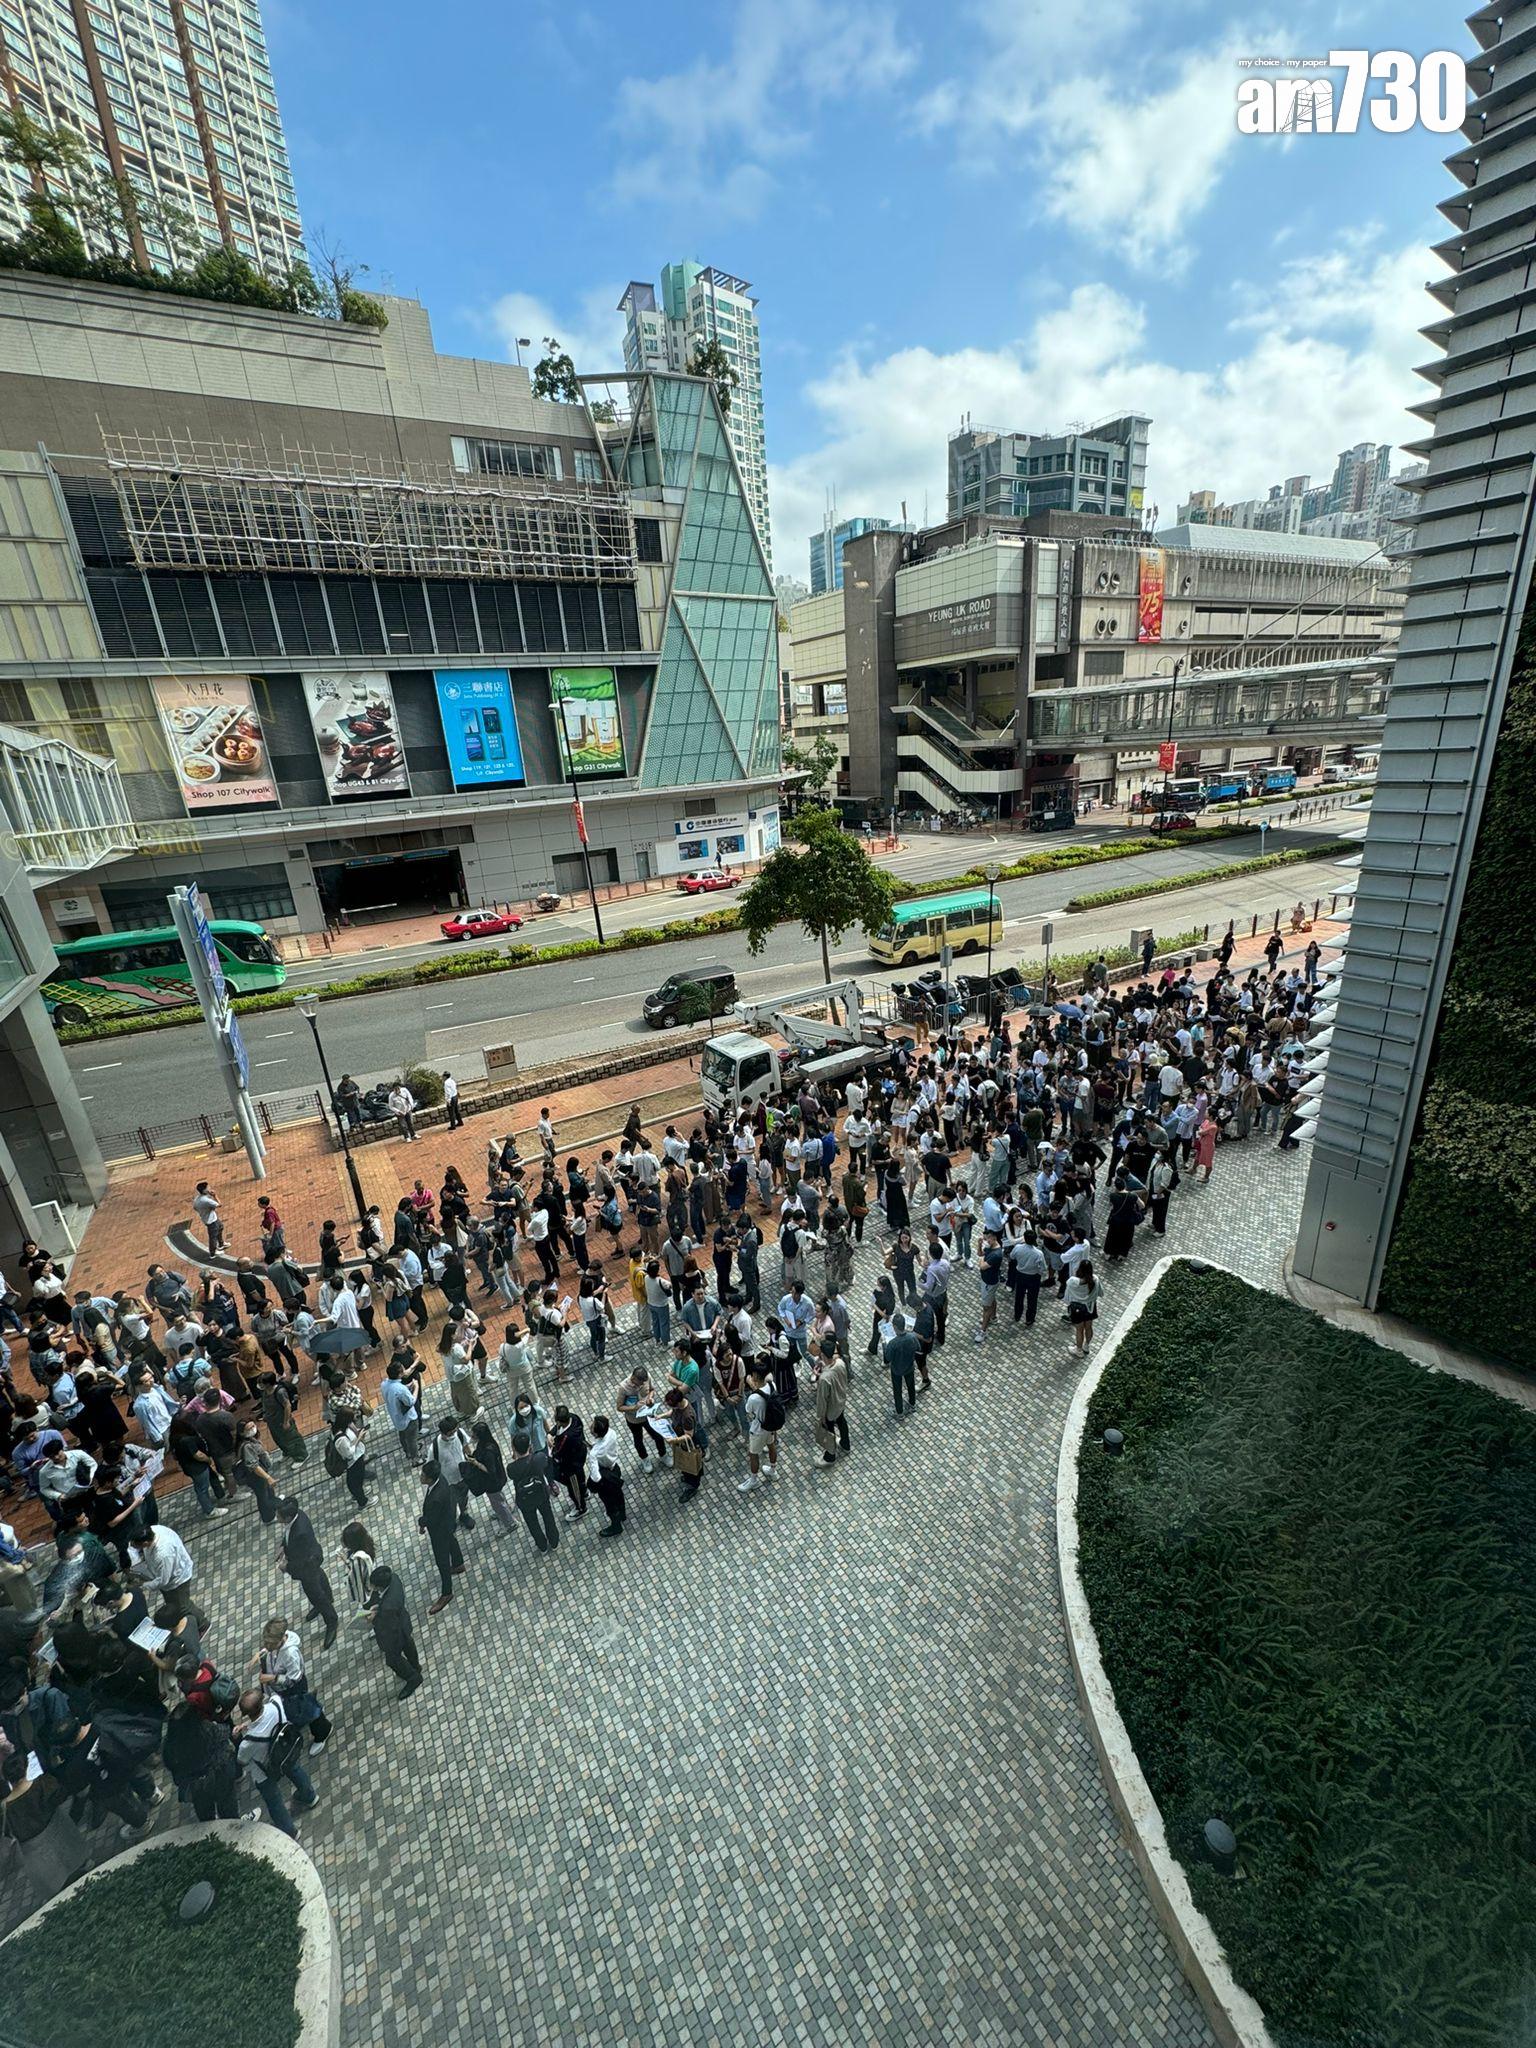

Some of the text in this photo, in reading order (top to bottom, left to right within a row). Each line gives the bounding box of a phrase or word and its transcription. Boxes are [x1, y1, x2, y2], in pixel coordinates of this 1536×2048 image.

[928, 607, 953, 623] YEUNG
[956, 604, 966, 617] UK
[969, 598, 991, 614] ROAD
[186, 682, 224, 696] 八月花
[596, 762, 621, 770] Citywalk
[191, 786, 271, 799] Shop 107 Citywalk
